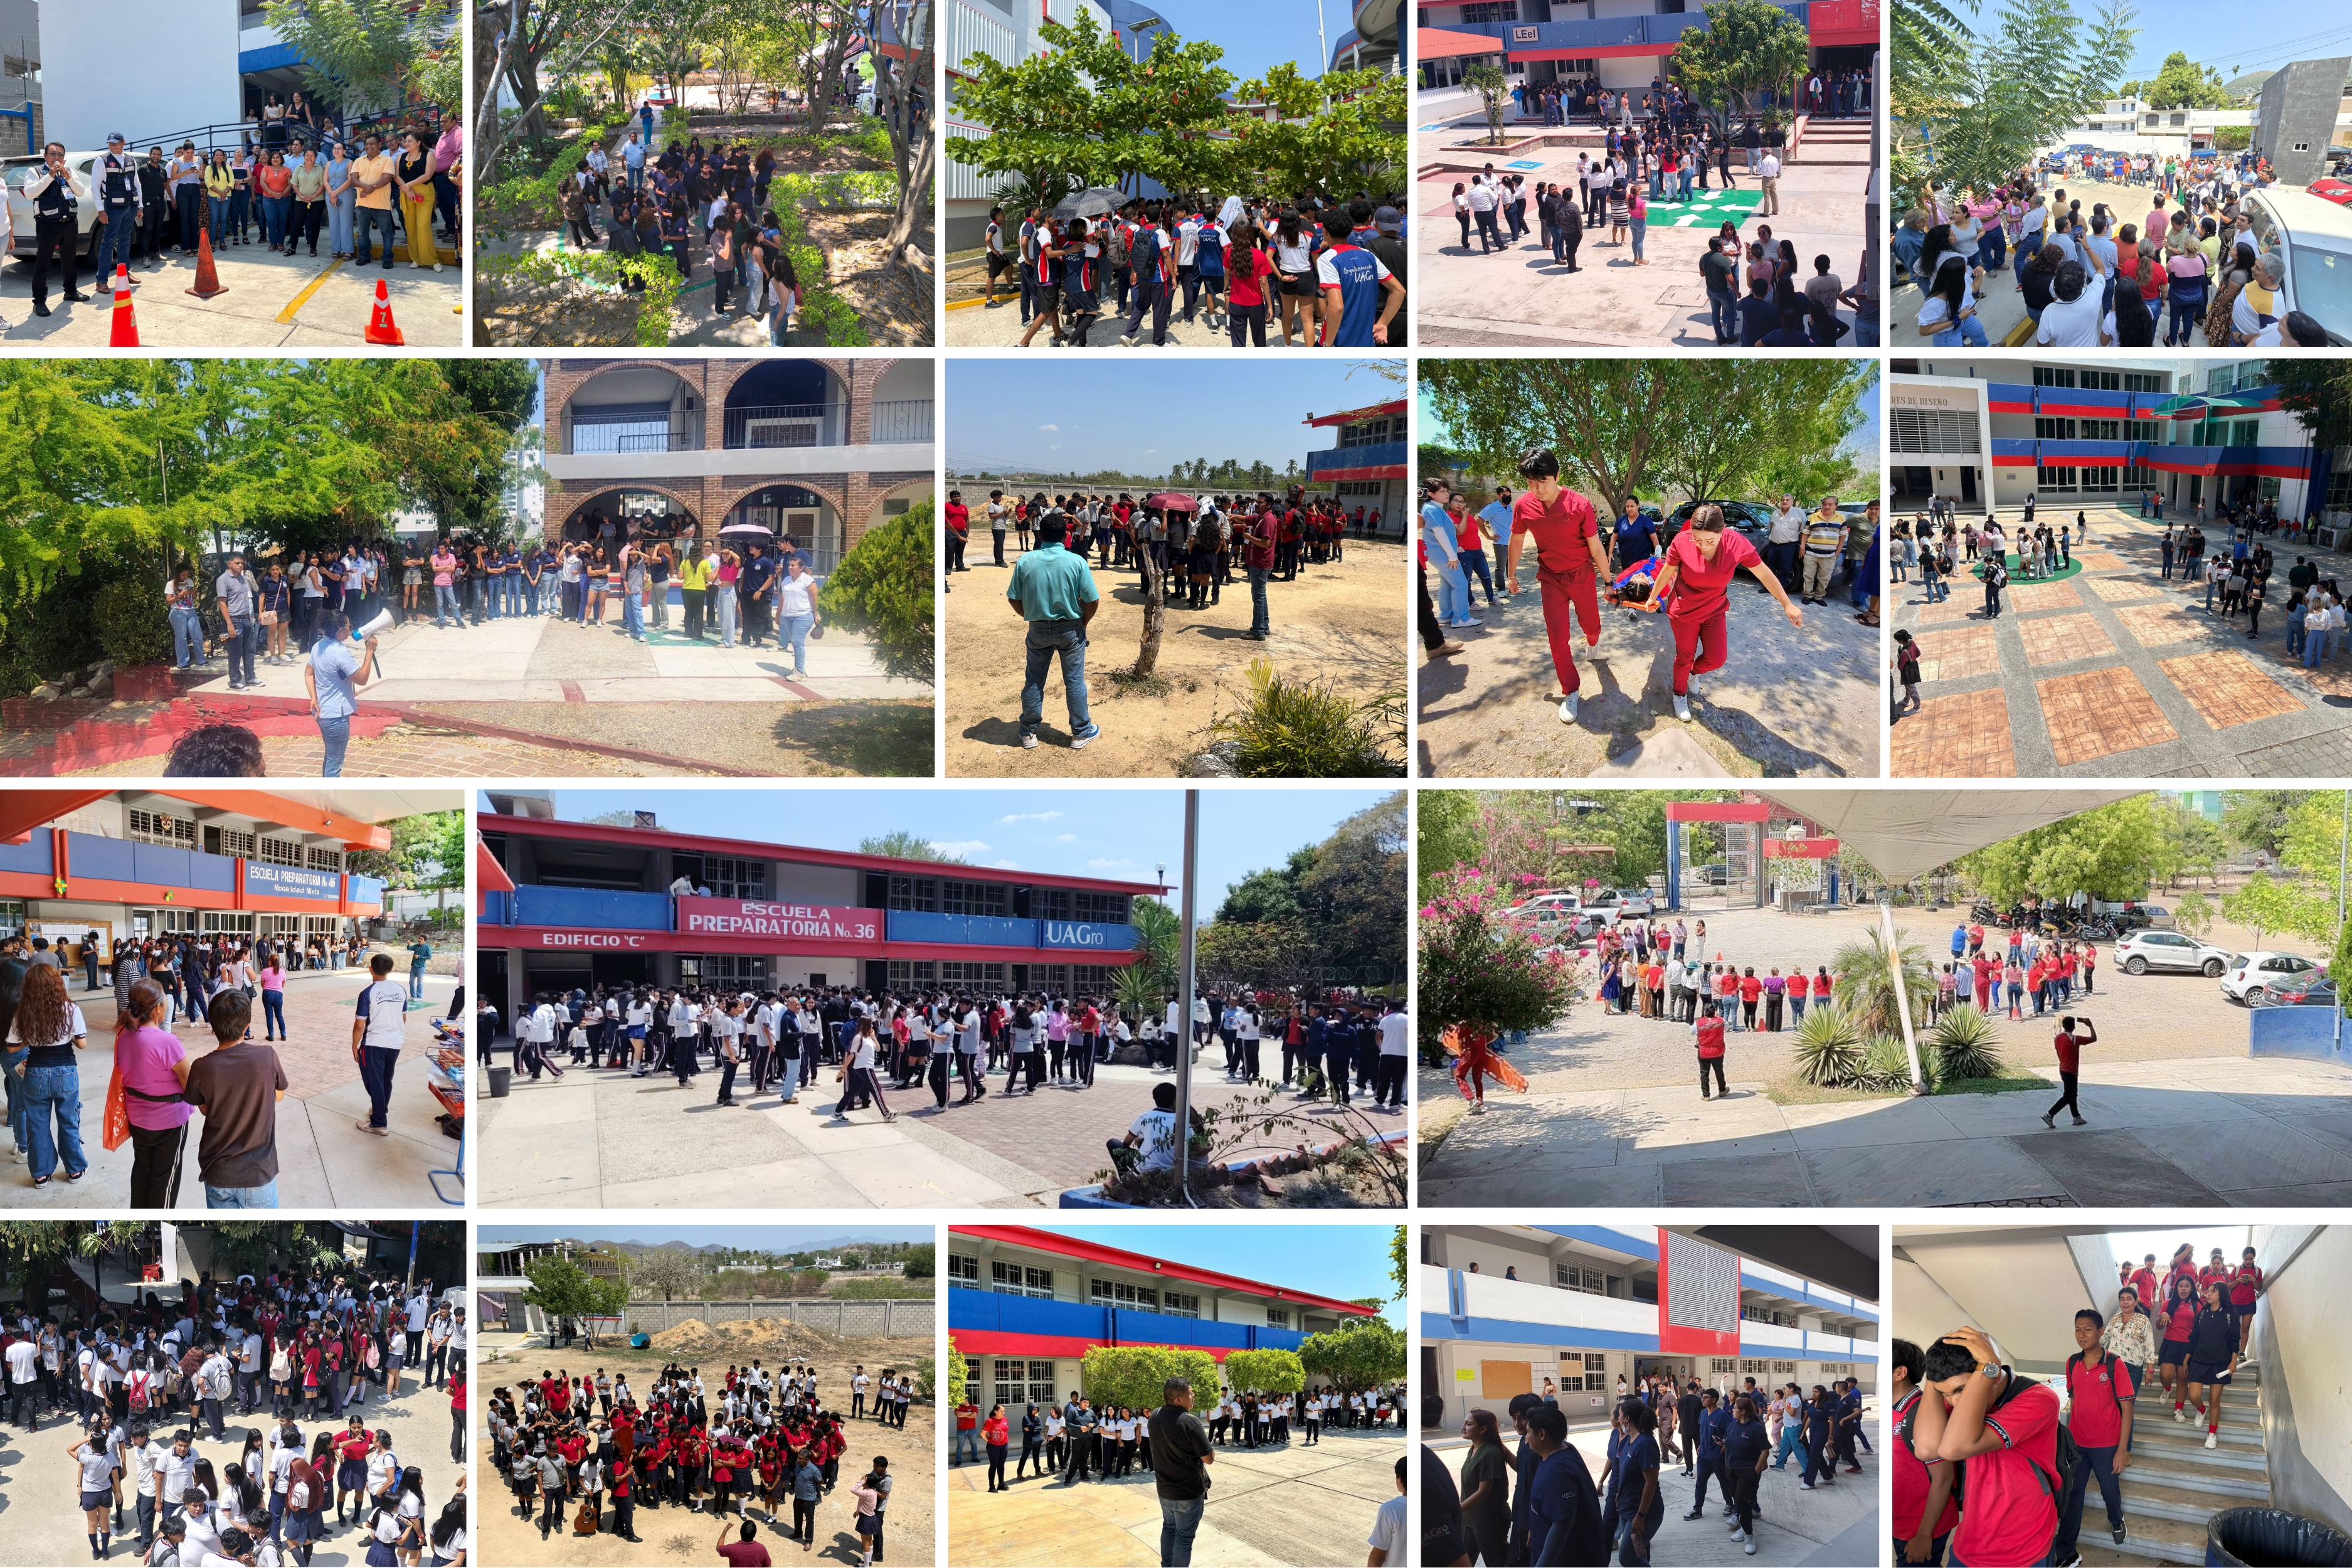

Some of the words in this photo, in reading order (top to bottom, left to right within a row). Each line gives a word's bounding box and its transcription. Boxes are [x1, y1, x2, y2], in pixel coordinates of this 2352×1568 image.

[379, 312, 386, 323] 7
[1890, 396, 1905, 405] RES
[1919, 398, 1947, 406] DISEÑO
[250, 866, 278, 881] ESCUELA
[281, 870, 320, 886] PREPARATORIA
[329, 877, 336, 887] 46
[274, 884, 304, 893] Modalidad
[741, 902, 830, 919] ESCUELA
[689, 914, 831, 937] PREPARATORIA
[835, 923, 853, 938] No.
[854, 924, 875, 939] 36
[1047, 922, 1103, 945] UAGro
[543, 933, 620, 946] EDIFICIO
[624, 935, 645, 946] "C"
